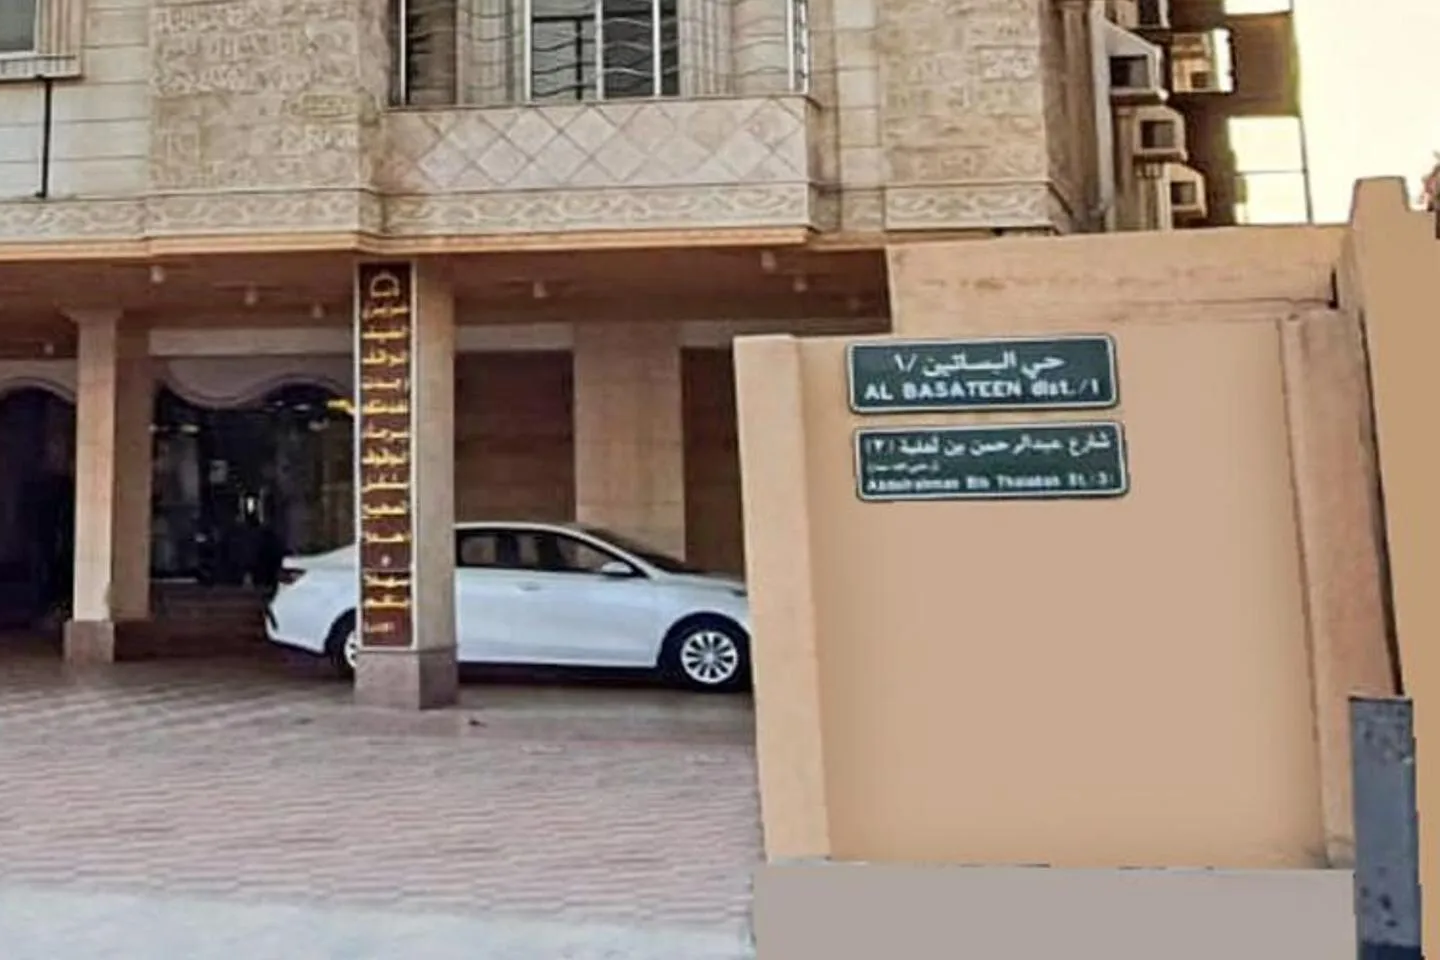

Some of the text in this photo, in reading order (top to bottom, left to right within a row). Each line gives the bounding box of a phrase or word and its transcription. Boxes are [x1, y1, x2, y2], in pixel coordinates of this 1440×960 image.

[922, 348, 1017, 377] البساتين
[1021, 356, 1065, 379] حي
[864, 381, 894, 400] AL
[903, 379, 1022, 400] BASATEEN
[1069, 431, 1111, 456] شارع
